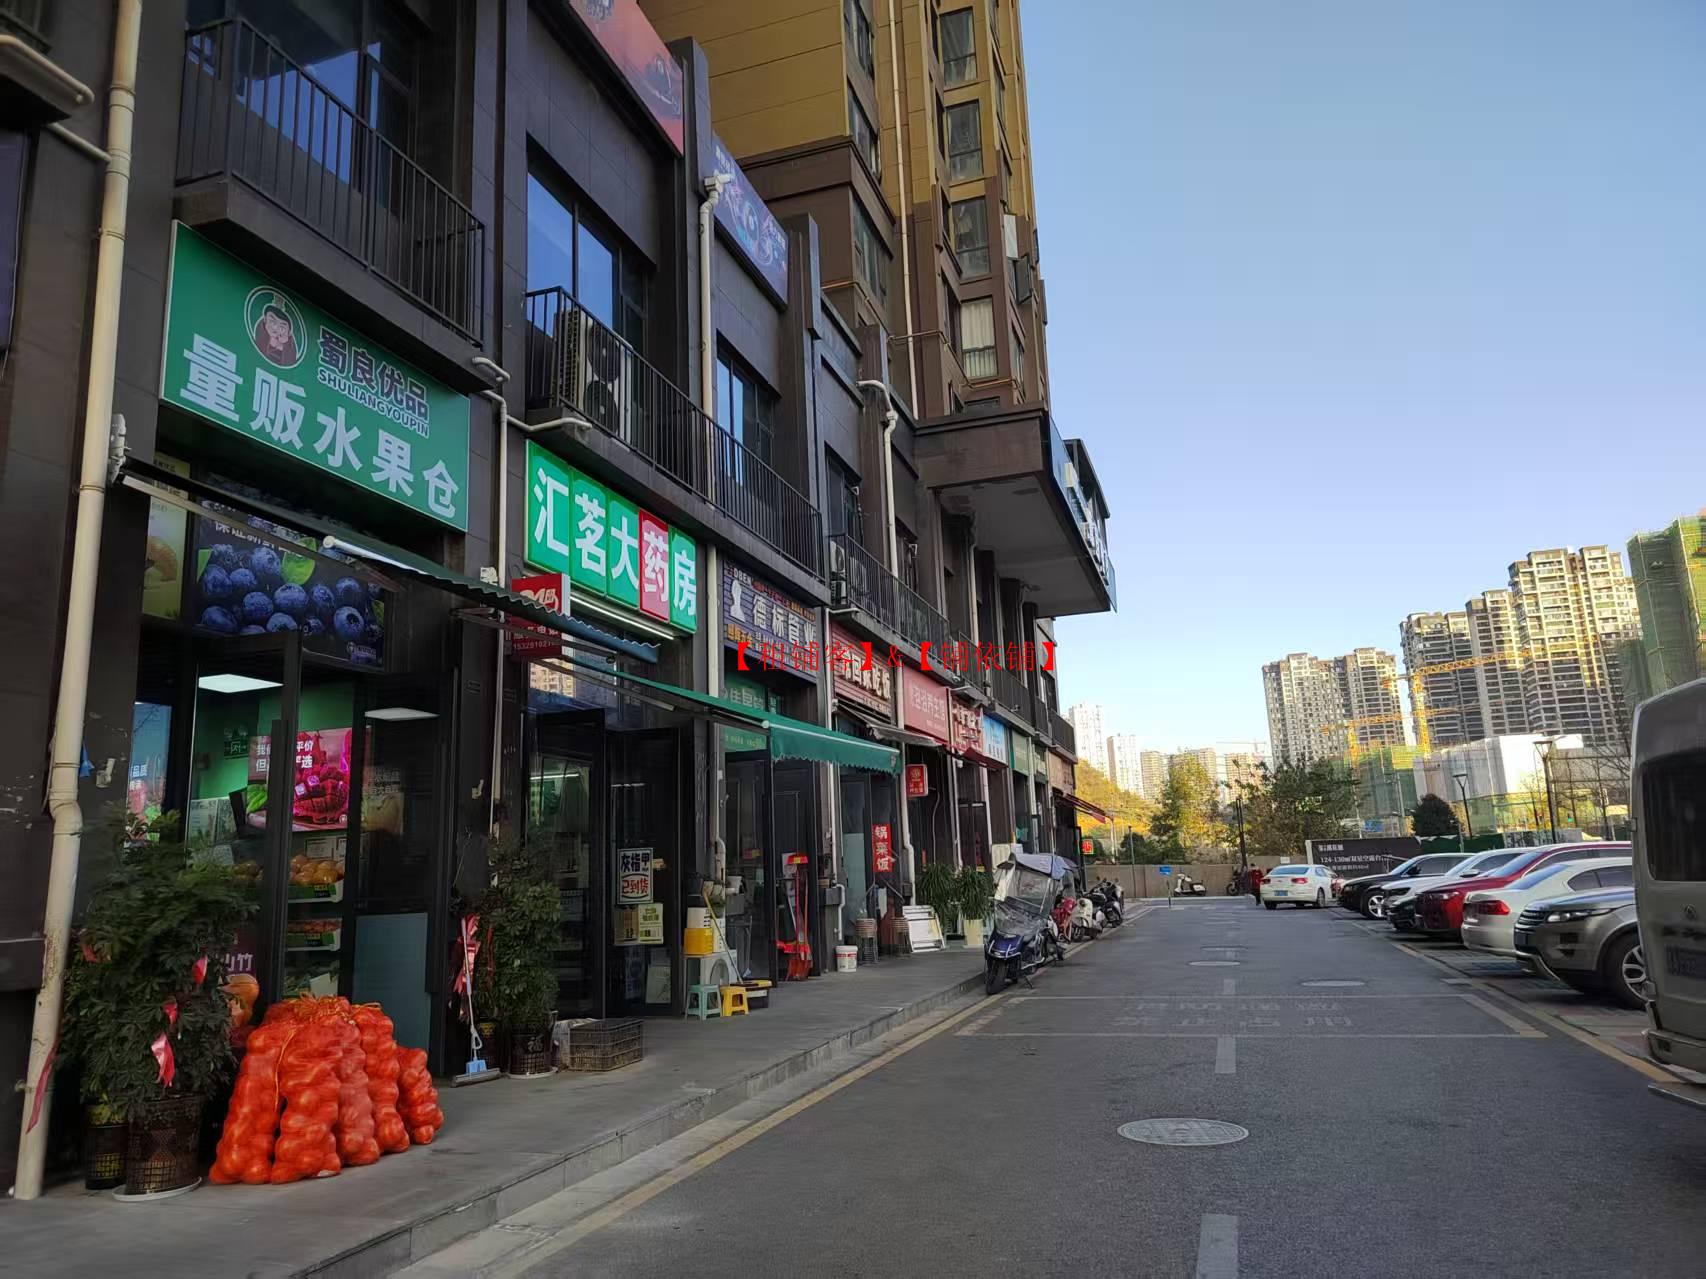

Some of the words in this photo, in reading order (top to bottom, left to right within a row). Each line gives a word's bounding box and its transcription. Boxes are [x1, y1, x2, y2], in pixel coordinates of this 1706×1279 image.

[318, 325, 430, 423] 蜀良优品
[318, 368, 430, 439] SHULIANGYOUPIN
[180, 333, 459, 518] 量贩水果仓
[533, 467, 697, 616] 汇茗大药房
[620, 853, 650, 872] 灰指甲
[622, 877, 649, 894] 已到货
